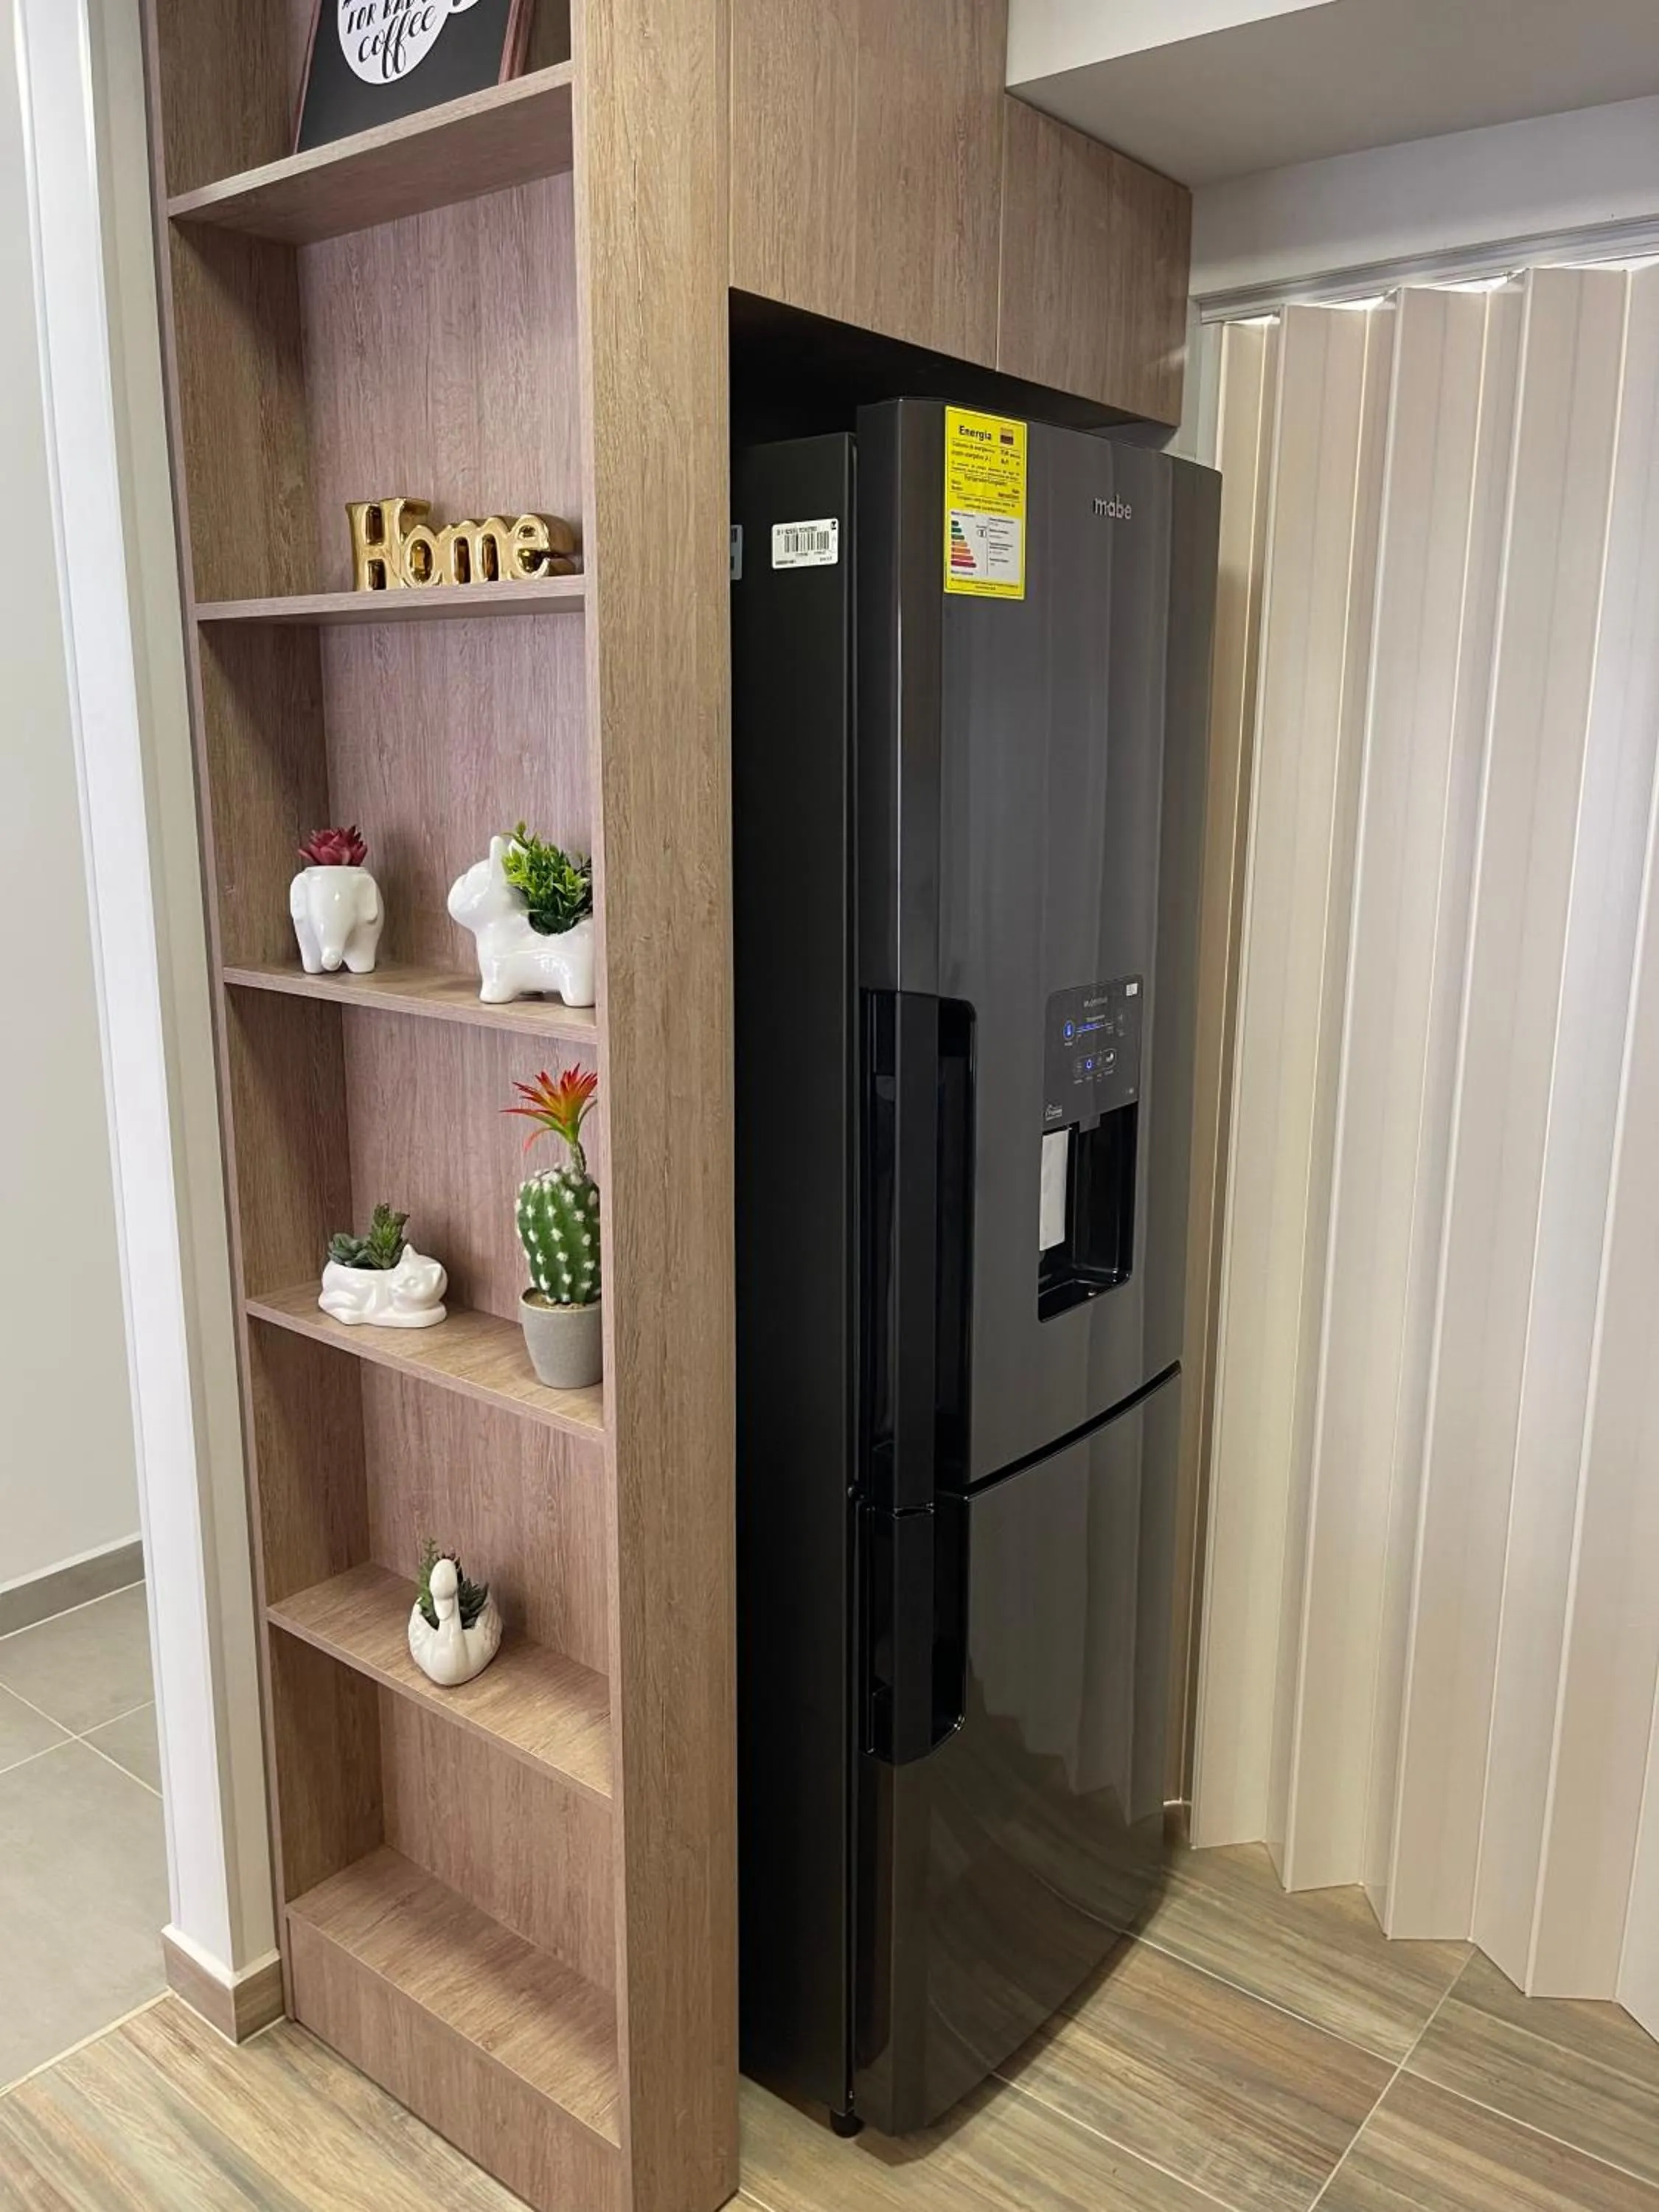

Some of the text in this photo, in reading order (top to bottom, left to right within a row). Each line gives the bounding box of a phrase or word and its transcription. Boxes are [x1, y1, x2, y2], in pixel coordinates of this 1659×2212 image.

[358, 5, 437, 79] coffee
[346, 497, 553, 591] Home
[1093, 494, 1132, 520] mabe
